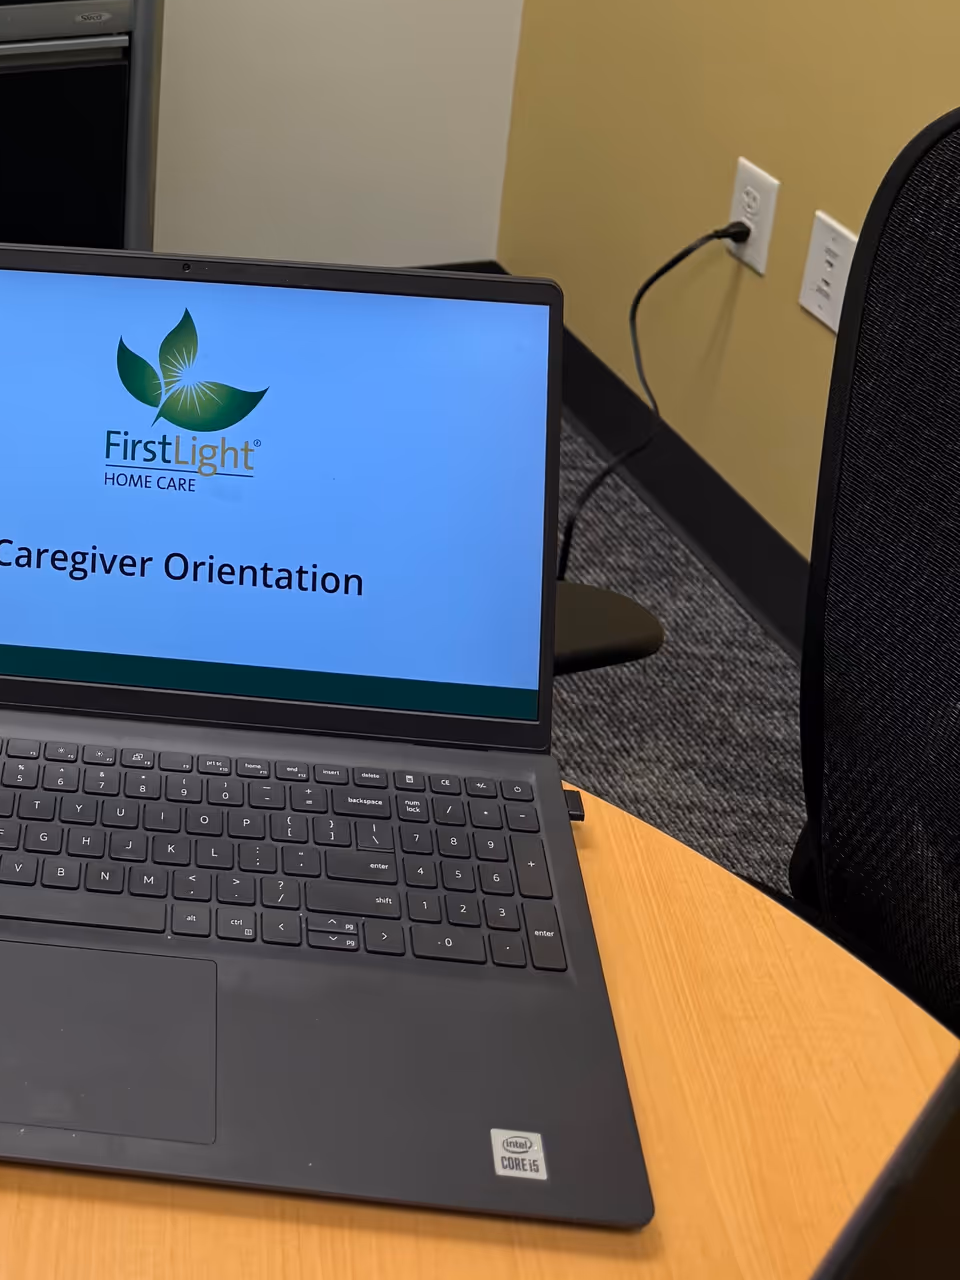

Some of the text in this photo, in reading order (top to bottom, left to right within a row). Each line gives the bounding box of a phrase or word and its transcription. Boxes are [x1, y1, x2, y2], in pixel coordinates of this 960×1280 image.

[104, 472, 196, 492] HOME CARE
[163, 552, 364, 596] Orientation
[33, 800, 41, 810] T
[347, 796, 383, 806] backspace
[75, 804, 83, 813] Y
[116, 808, 125, 817] U
[406, 805, 421, 813] lock
[200, 815, 209, 825] O
[243, 818, 251, 827] P
[39, 832, 48, 842] G
[82, 836, 91, 846] H
[413, 833, 420, 842] 7
[450, 836, 458, 846] 8
[125, 840, 132, 850] J
[167, 844, 175, 853] K
[487, 840, 495, 849] 9
[211, 848, 218, 857] L
[14, 863, 23, 872] V
[57, 867, 65, 877] B
[417, 867, 424, 875] 4
[100, 871, 110, 881] N
[455, 870, 462, 879] 5
[492, 873, 500, 882] 6
[143, 875, 154, 885] M
[375, 896, 393, 905] shift
[186, 914, 196, 922] alt
[506, 1139, 528, 1150] intel
[501, 1155, 540, 1173] CORE i5
